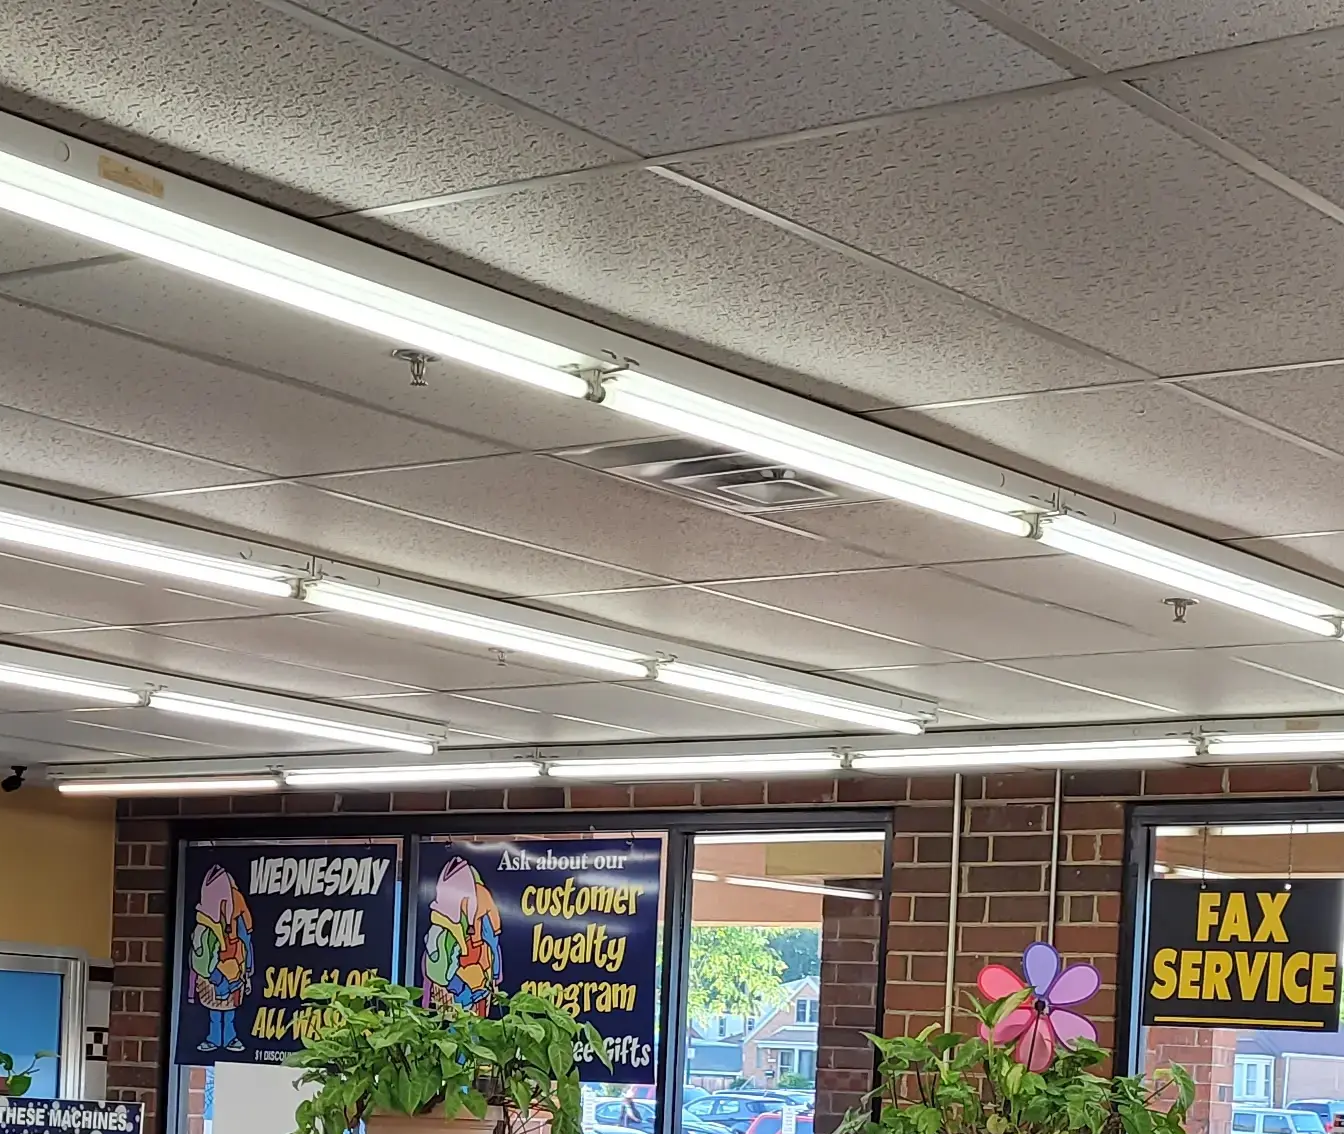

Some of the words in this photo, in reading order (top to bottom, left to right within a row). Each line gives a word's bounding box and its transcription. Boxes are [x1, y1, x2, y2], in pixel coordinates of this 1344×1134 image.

[248, 856, 391, 897] WEDNESDAY
[497, 850, 532, 871] Ask
[536, 849, 588, 871] about
[593, 853, 628, 870] our
[520, 877, 645, 920] customer
[1196, 892, 1292, 943] FAX
[274, 908, 366, 948] SPECIAL
[532, 923, 627, 973] loyalty
[263, 965, 313, 1000] SAVE
[1150, 948, 1338, 1004] SERVICE
[251, 1006, 287, 1040] ALL
[603, 1035, 652, 1068] Gifts
[48, 1108, 128, 1132] MACHINES
